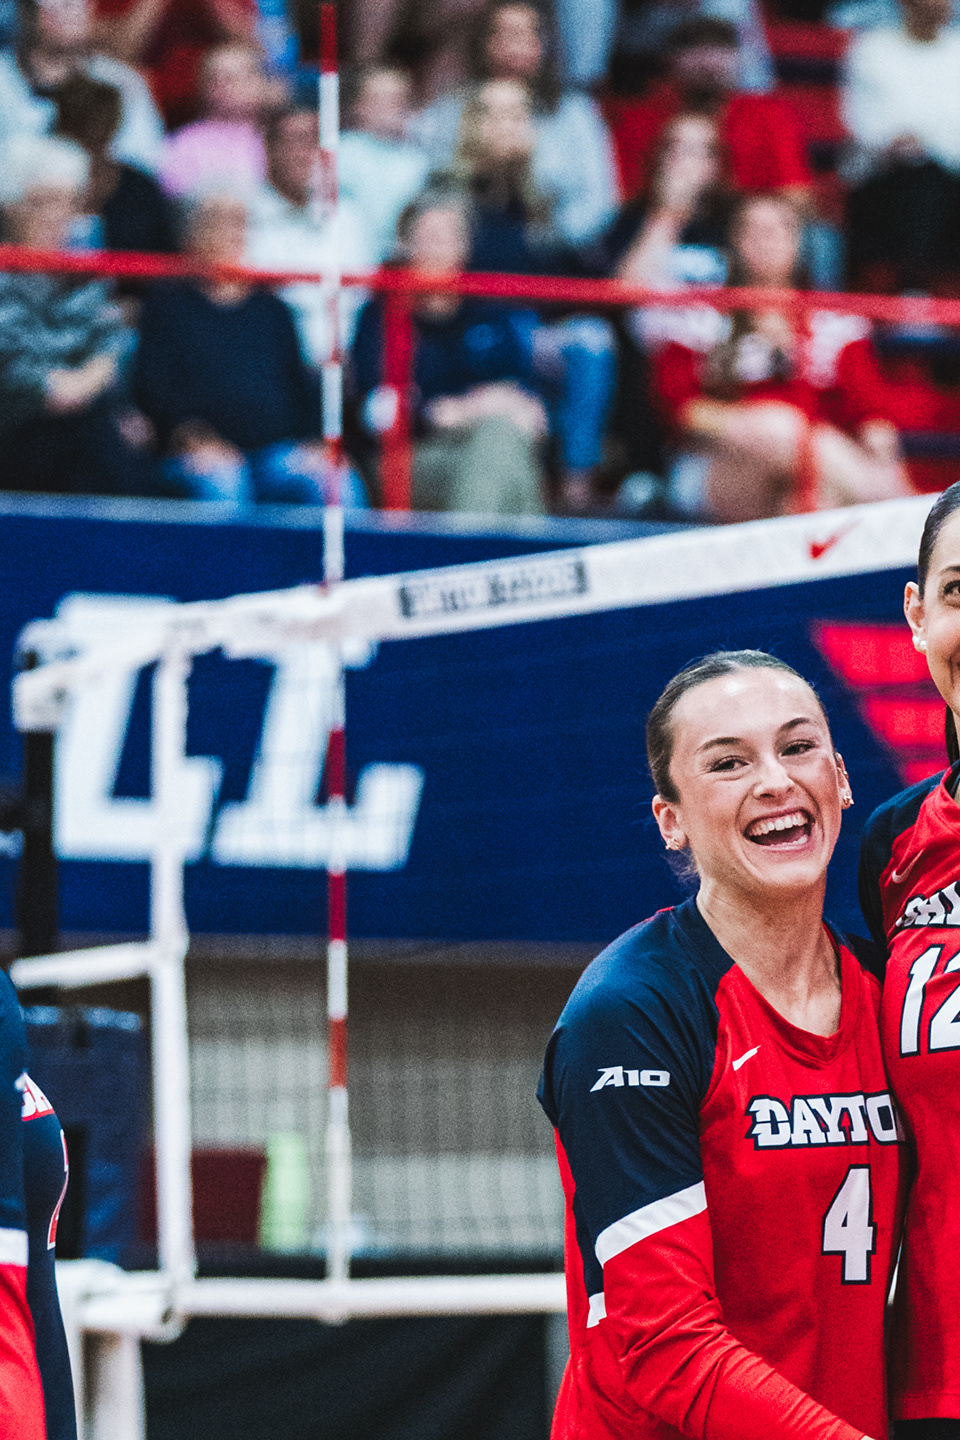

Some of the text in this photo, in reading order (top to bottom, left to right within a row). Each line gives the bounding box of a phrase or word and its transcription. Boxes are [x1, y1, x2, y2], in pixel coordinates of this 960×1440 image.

[589, 1065, 671, 1092] A10
[745, 1090, 906, 1150] DAYTO
[821, 1163, 877, 1285] 4
